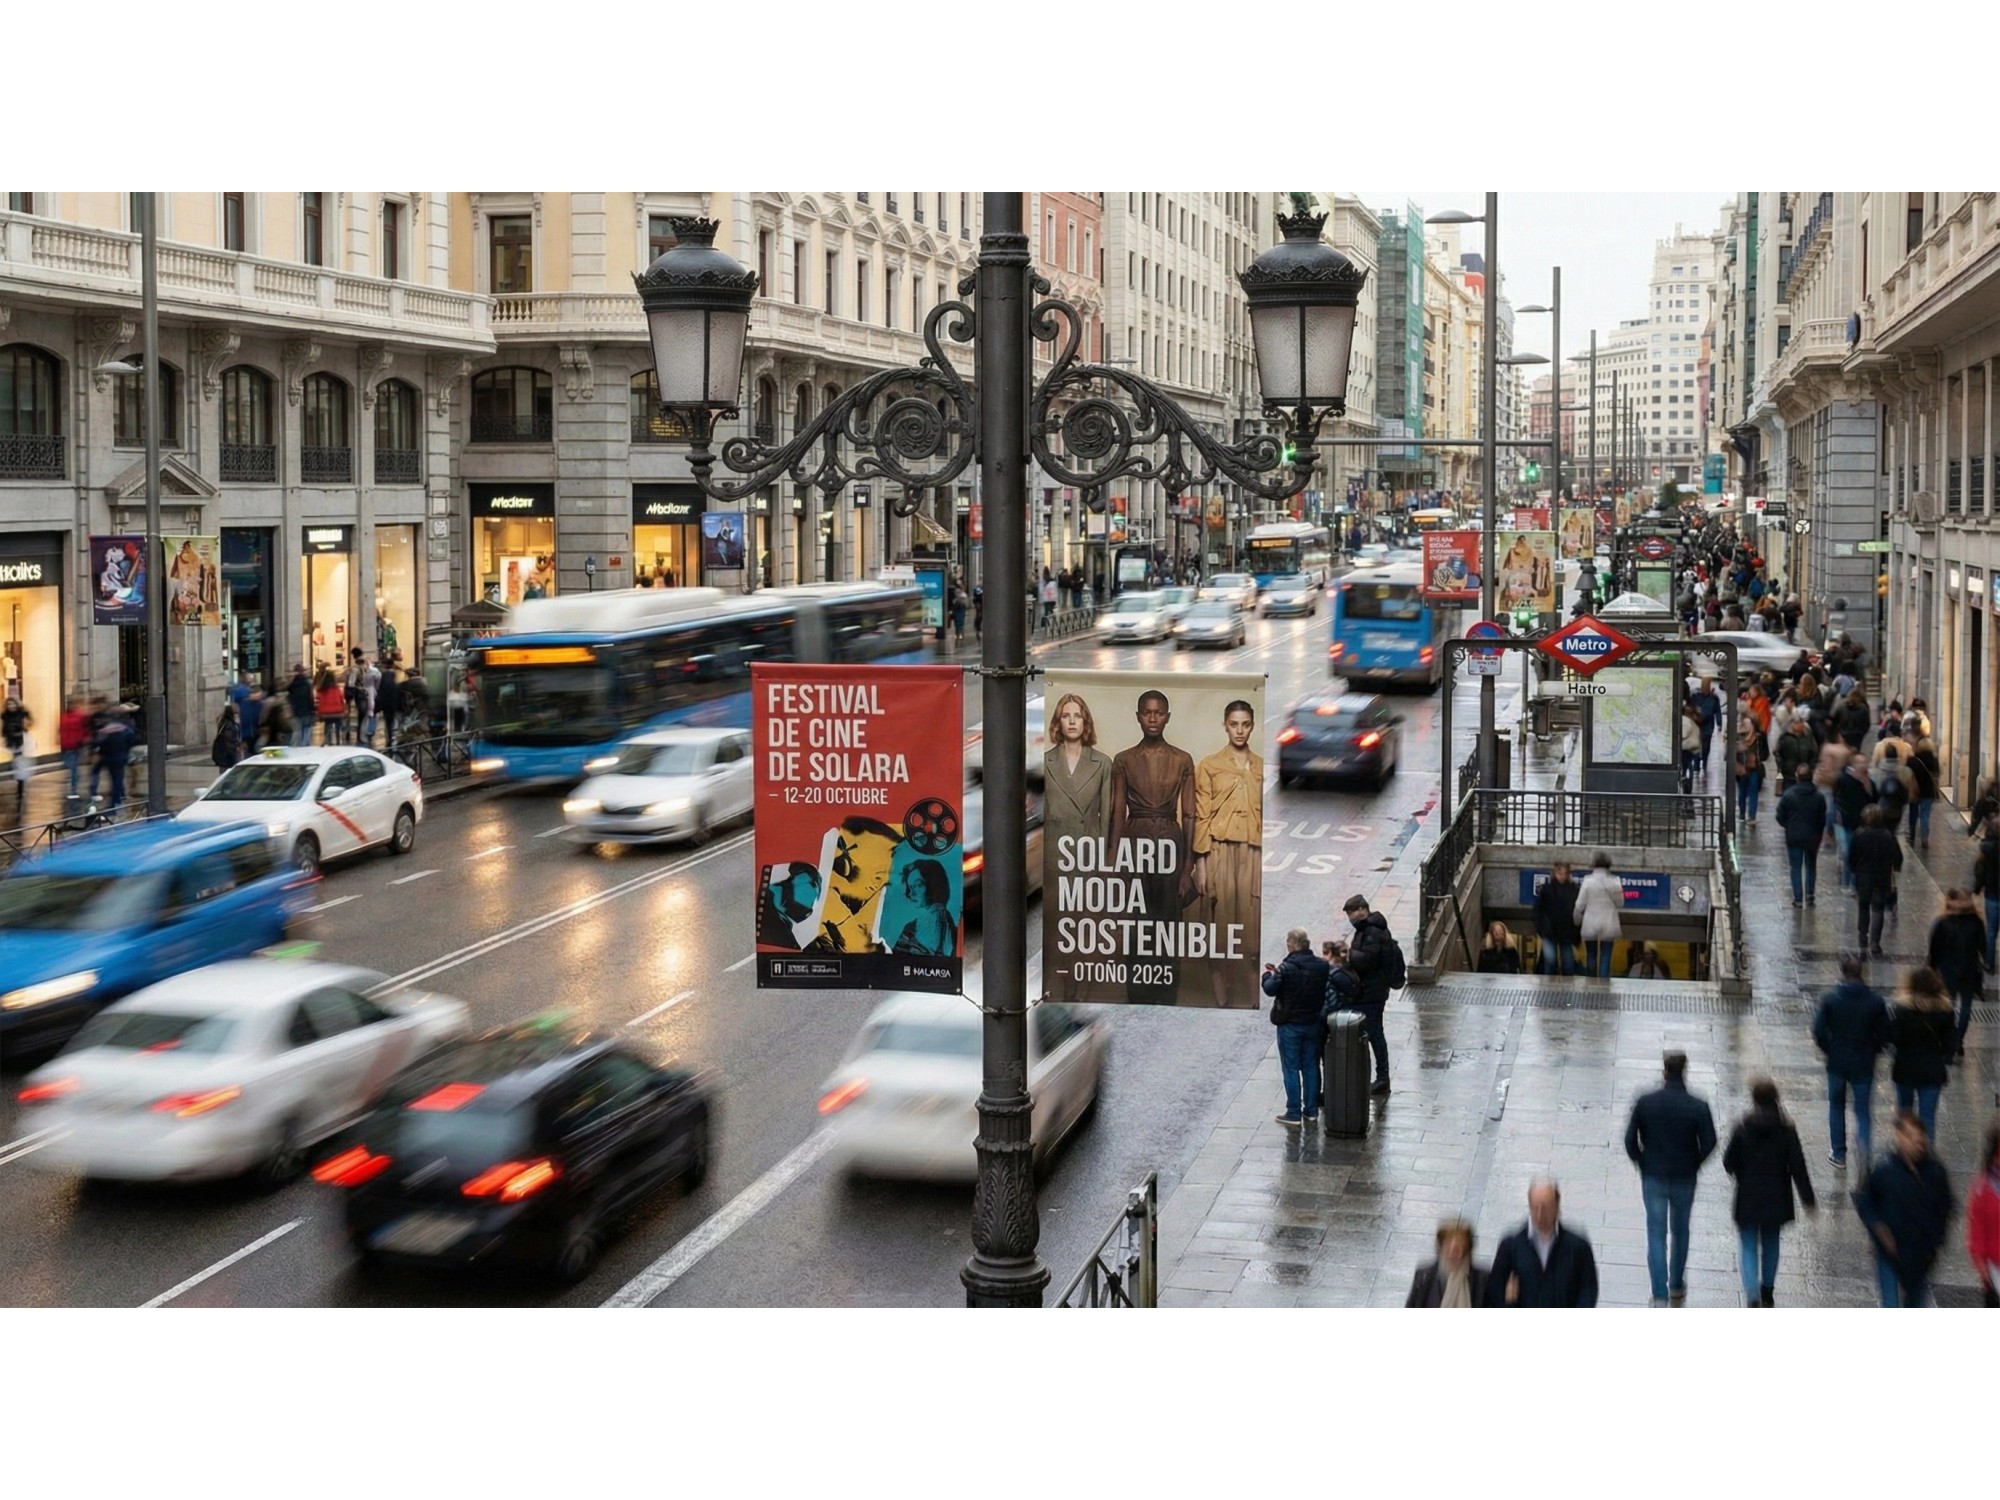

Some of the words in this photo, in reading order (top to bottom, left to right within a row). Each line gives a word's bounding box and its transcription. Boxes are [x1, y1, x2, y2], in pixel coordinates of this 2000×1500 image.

[1566, 638, 1607, 651] Metro
[768, 683, 885, 715] FESTIVAL
[1568, 683, 1607, 695] Hatro
[768, 717, 800, 748] DE
[809, 718, 867, 749] CINE
[768, 751, 801, 782] DE
[809, 752, 909, 783] SOLARA
[784, 787, 822, 804] 12-20
[825, 788, 889, 805] OCTUBRE
[1263, 820, 1372, 842] BUS
[1057, 835, 1177, 874] SOLARD
[1058, 876, 1147, 914] MODA
[1057, 917, 1244, 960] SOSTENIBLE
[1074, 959, 1127, 983] OTOÑO
[1132, 964, 1173, 985] 2025
